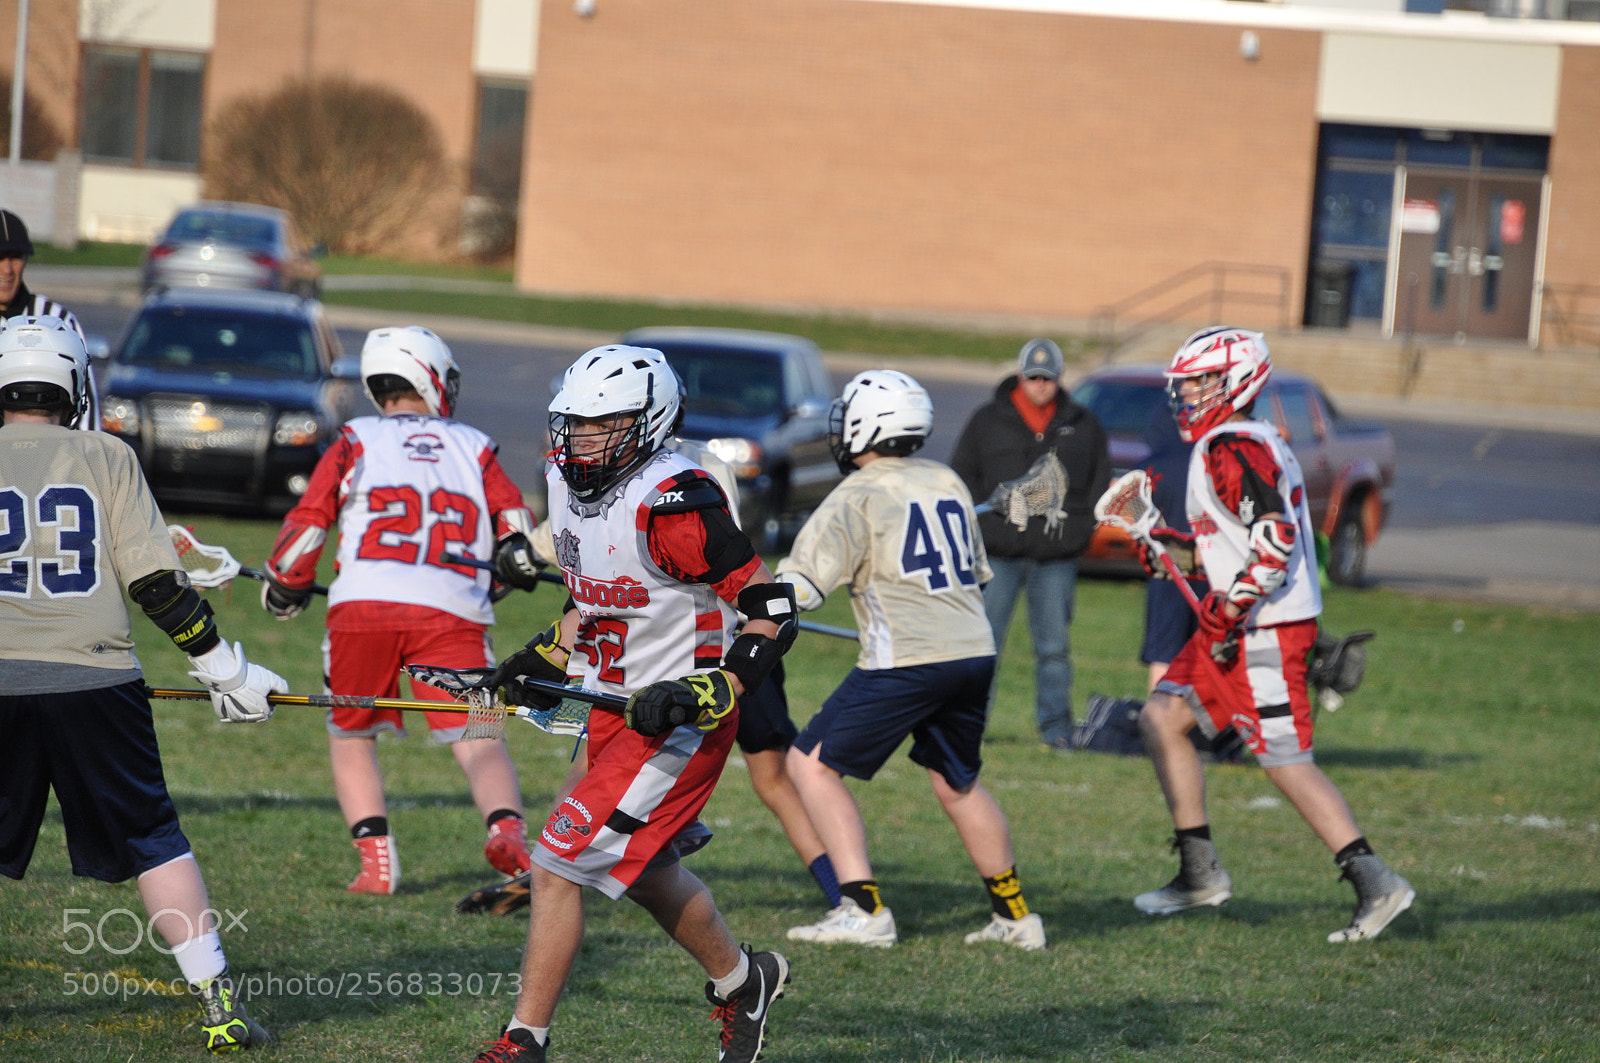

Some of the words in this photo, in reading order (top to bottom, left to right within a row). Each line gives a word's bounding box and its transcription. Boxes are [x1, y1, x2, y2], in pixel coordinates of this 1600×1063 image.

[653, 490, 685, 507] STX
[356, 484, 480, 579] 22
[899, 495, 978, 595] 40
[749, 644, 760, 658] STX
